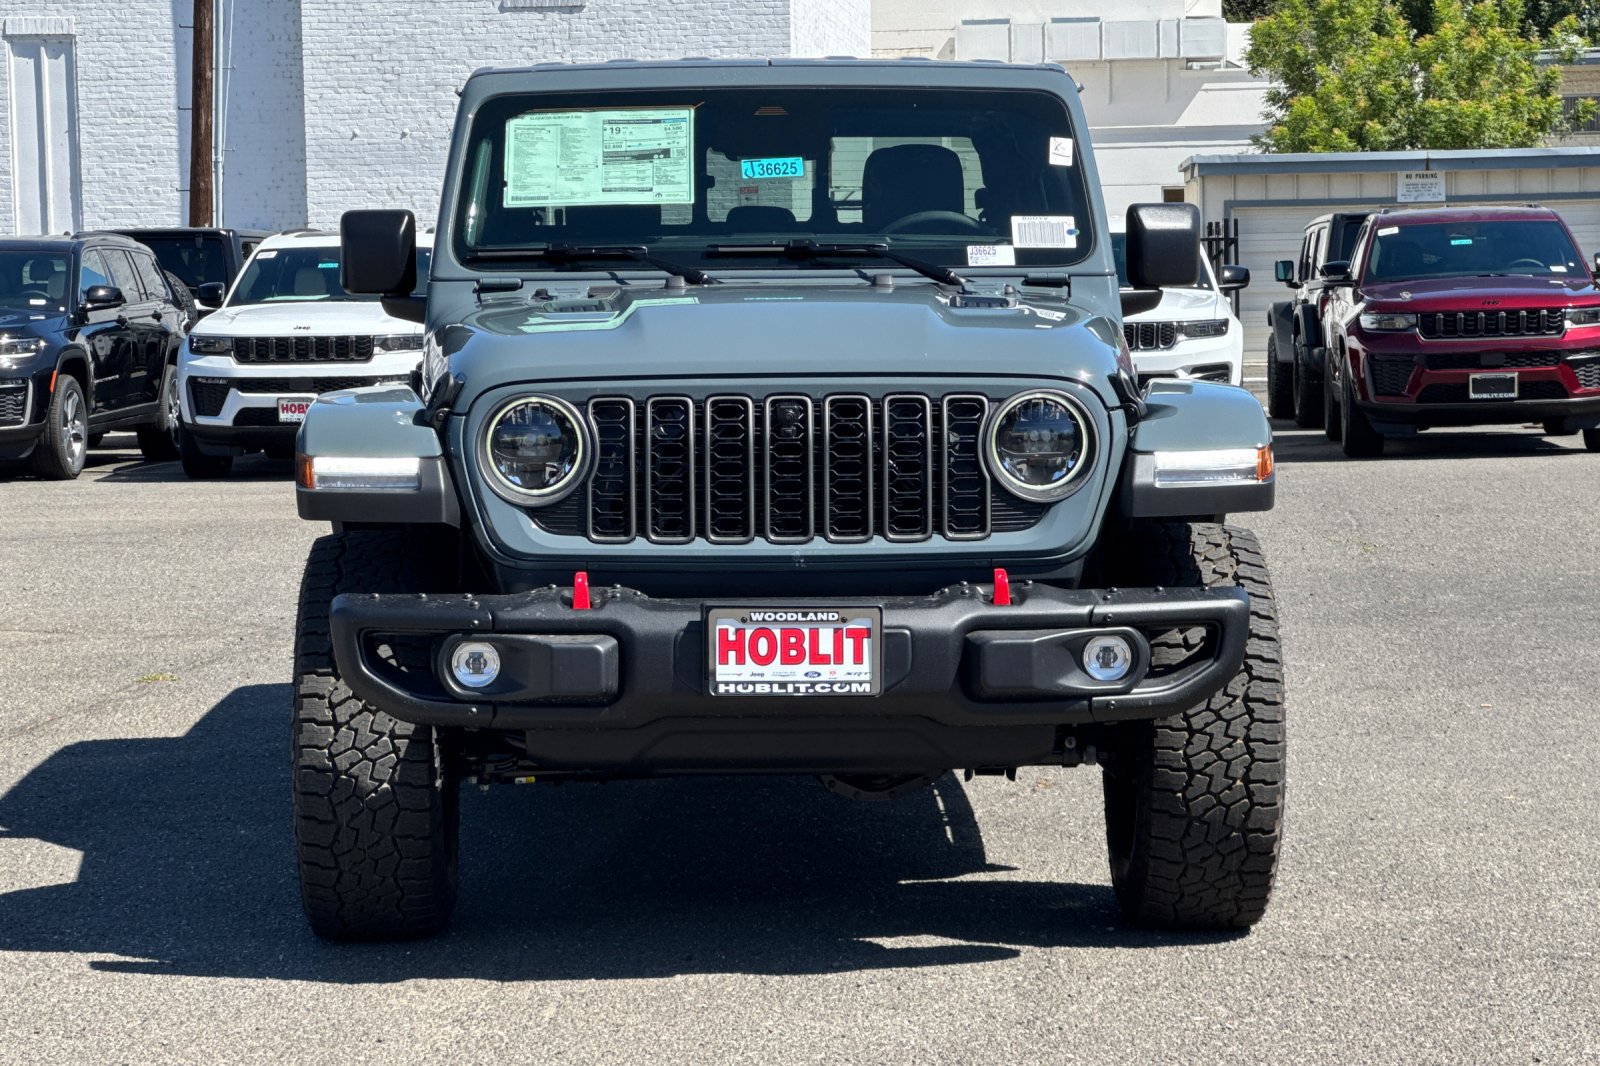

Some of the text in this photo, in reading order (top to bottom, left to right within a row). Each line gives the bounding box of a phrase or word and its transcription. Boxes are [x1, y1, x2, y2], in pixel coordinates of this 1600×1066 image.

[609, 126, 621, 135] 19
[743, 160, 798, 178] J36625
[969, 246, 997, 256] J36625
[750, 612, 839, 621] WOODLAND
[718, 627, 871, 666] HOBLIT
[719, 683, 871, 693] HOBLIT.COM
